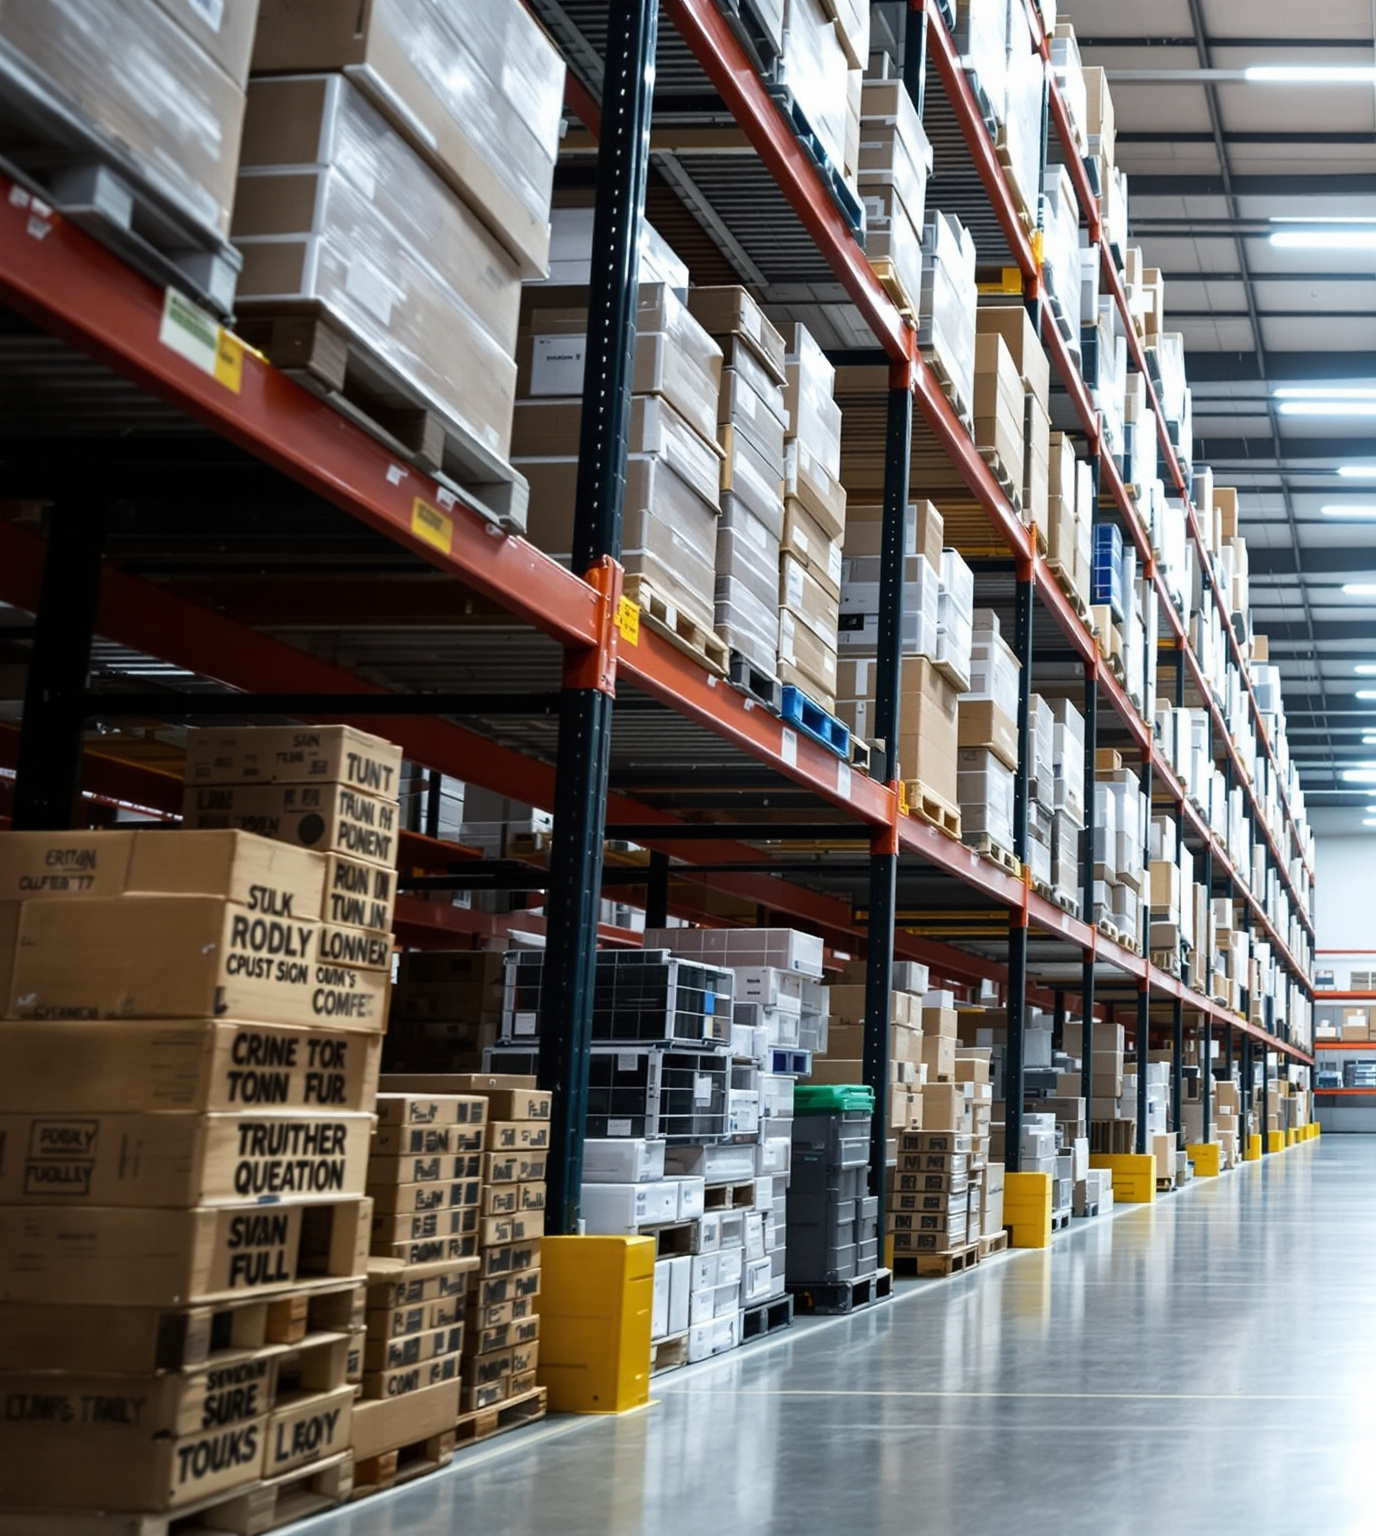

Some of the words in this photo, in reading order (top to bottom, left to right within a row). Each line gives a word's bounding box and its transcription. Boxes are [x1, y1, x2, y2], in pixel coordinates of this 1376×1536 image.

[347, 752, 394, 792] TUNT
[231, 914, 313, 959] RODLY
[320, 929, 389, 967] LONNER
[226, 953, 274, 980] CPUST
[231, 1033, 299, 1067] CRINE
[228, 1071, 290, 1104] TONN
[238, 1123, 347, 1158] TRUITHER
[234, 1159, 346, 1196] QUEATION
[228, 1250, 290, 1288] FULL
[202, 1384, 258, 1428] SURE
[177, 1425, 258, 1485] TOUKS
